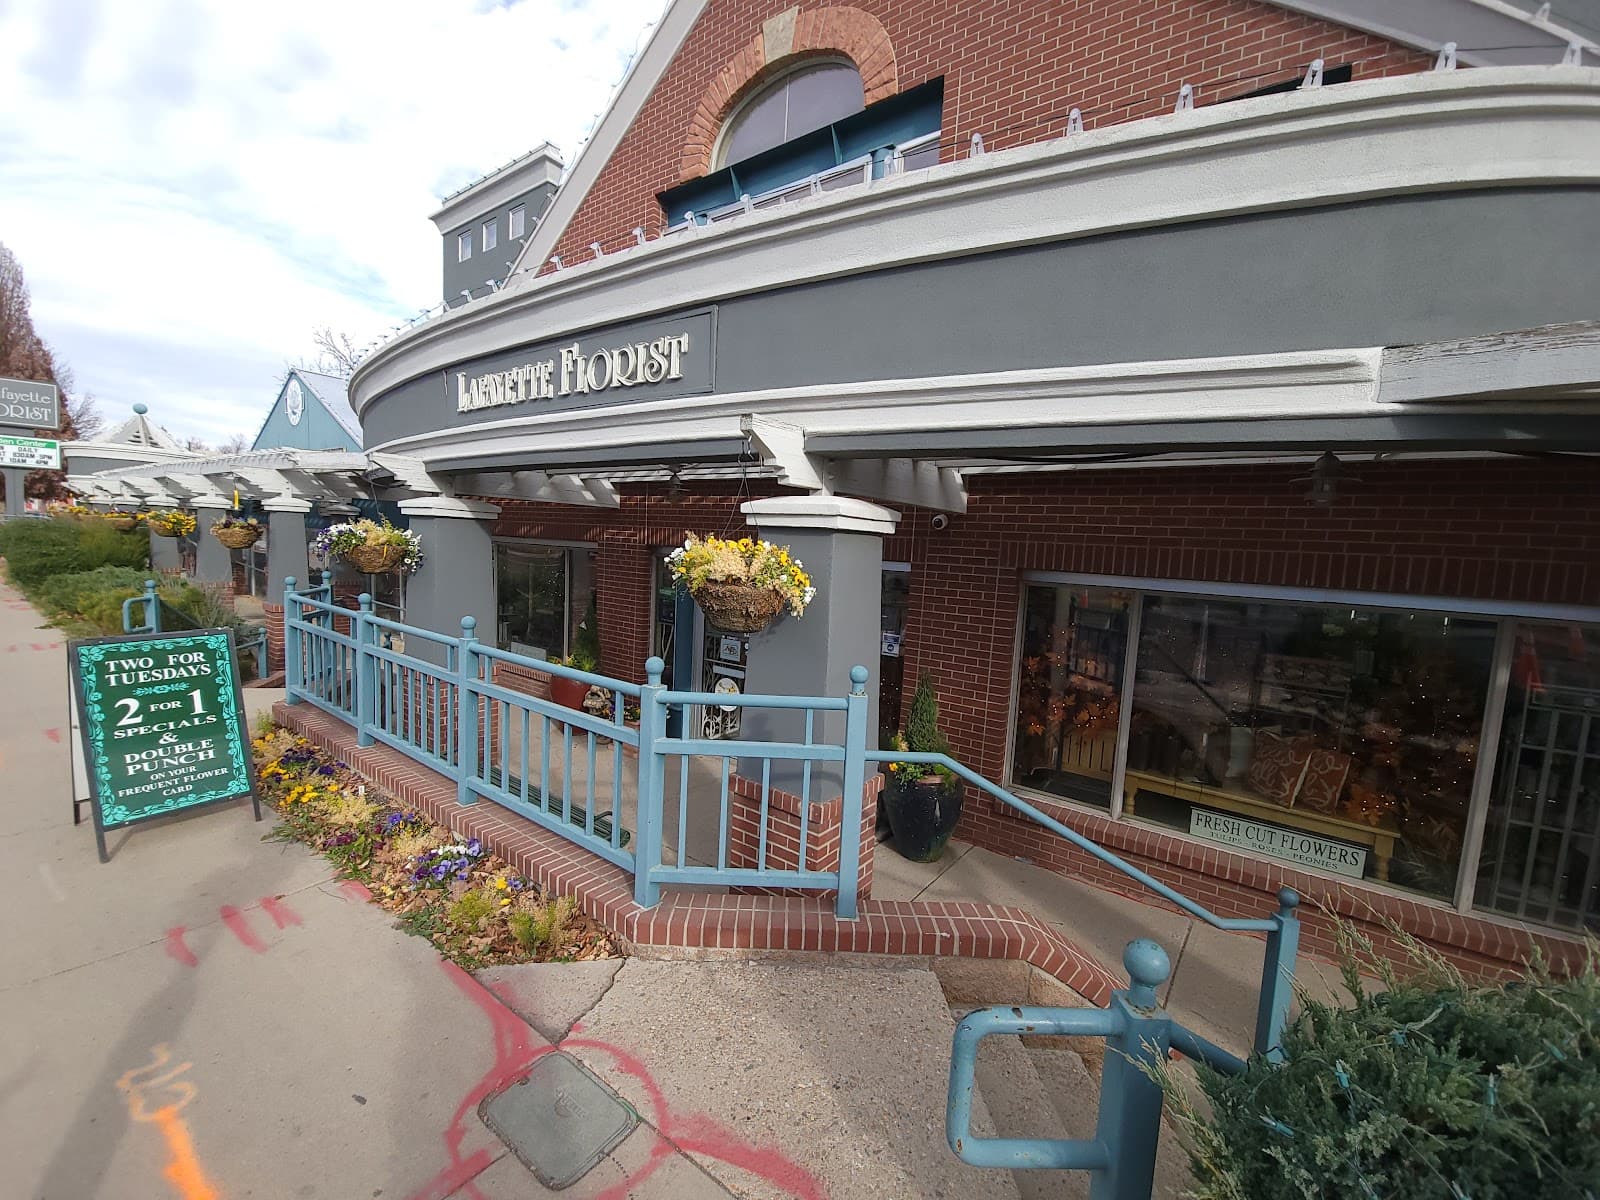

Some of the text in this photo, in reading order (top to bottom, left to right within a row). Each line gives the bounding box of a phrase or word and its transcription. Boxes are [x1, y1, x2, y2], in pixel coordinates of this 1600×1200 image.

[105, 652, 206, 673] TWO FOR
[105, 664, 212, 687] TUESDAYS
[114, 689, 208, 727] 2 FOR 1
[114, 715, 218, 739] SPECIALS
[159, 732, 179, 744] &
[123, 738, 214, 764] DOUBLE
[126, 750, 217, 776] PUNCH
[150, 765, 197, 781] ON YOUR
[118, 767, 229, 798] FREQUENT FLOWER
[162, 784, 193, 797] CARD
[1194, 813, 1359, 866] FRESH CUT FLOWERS
[1293, 853, 1339, 870] PEONIES
